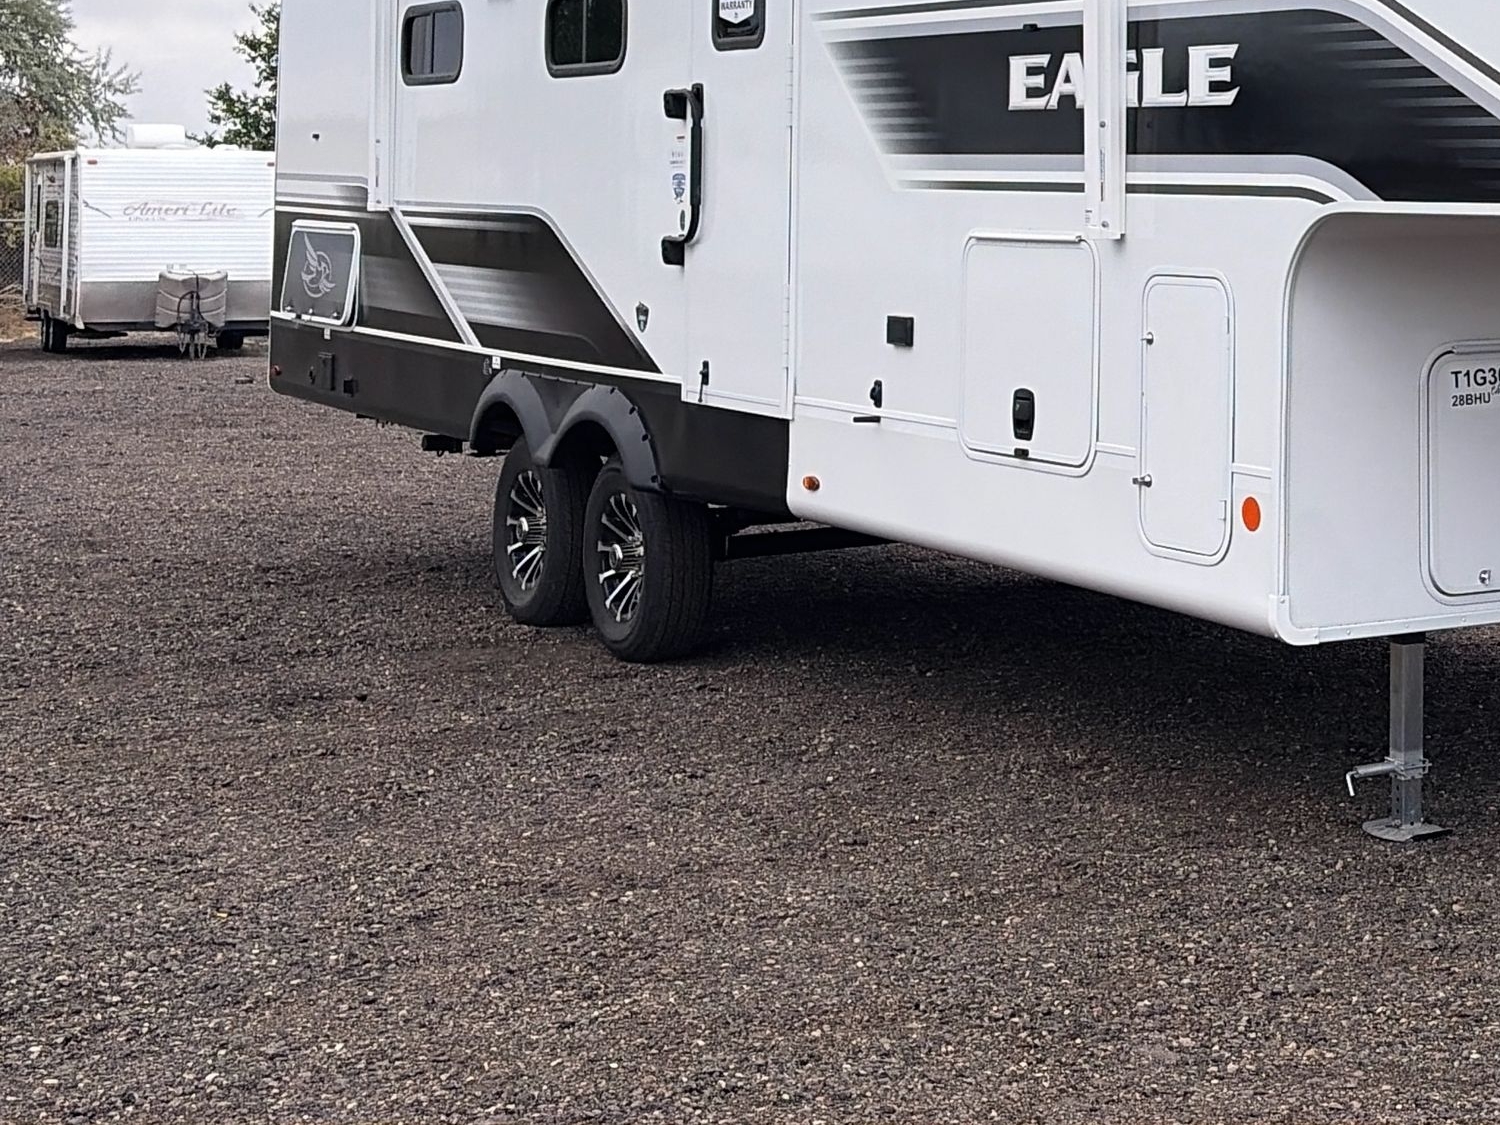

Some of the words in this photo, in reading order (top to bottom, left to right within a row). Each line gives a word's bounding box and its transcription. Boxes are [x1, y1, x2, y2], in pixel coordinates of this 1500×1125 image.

[720, 0, 753, 11] WARRANTY
[1007, 43, 1241, 111] EALE
[1451, 392, 1491, 407] 28BHU
